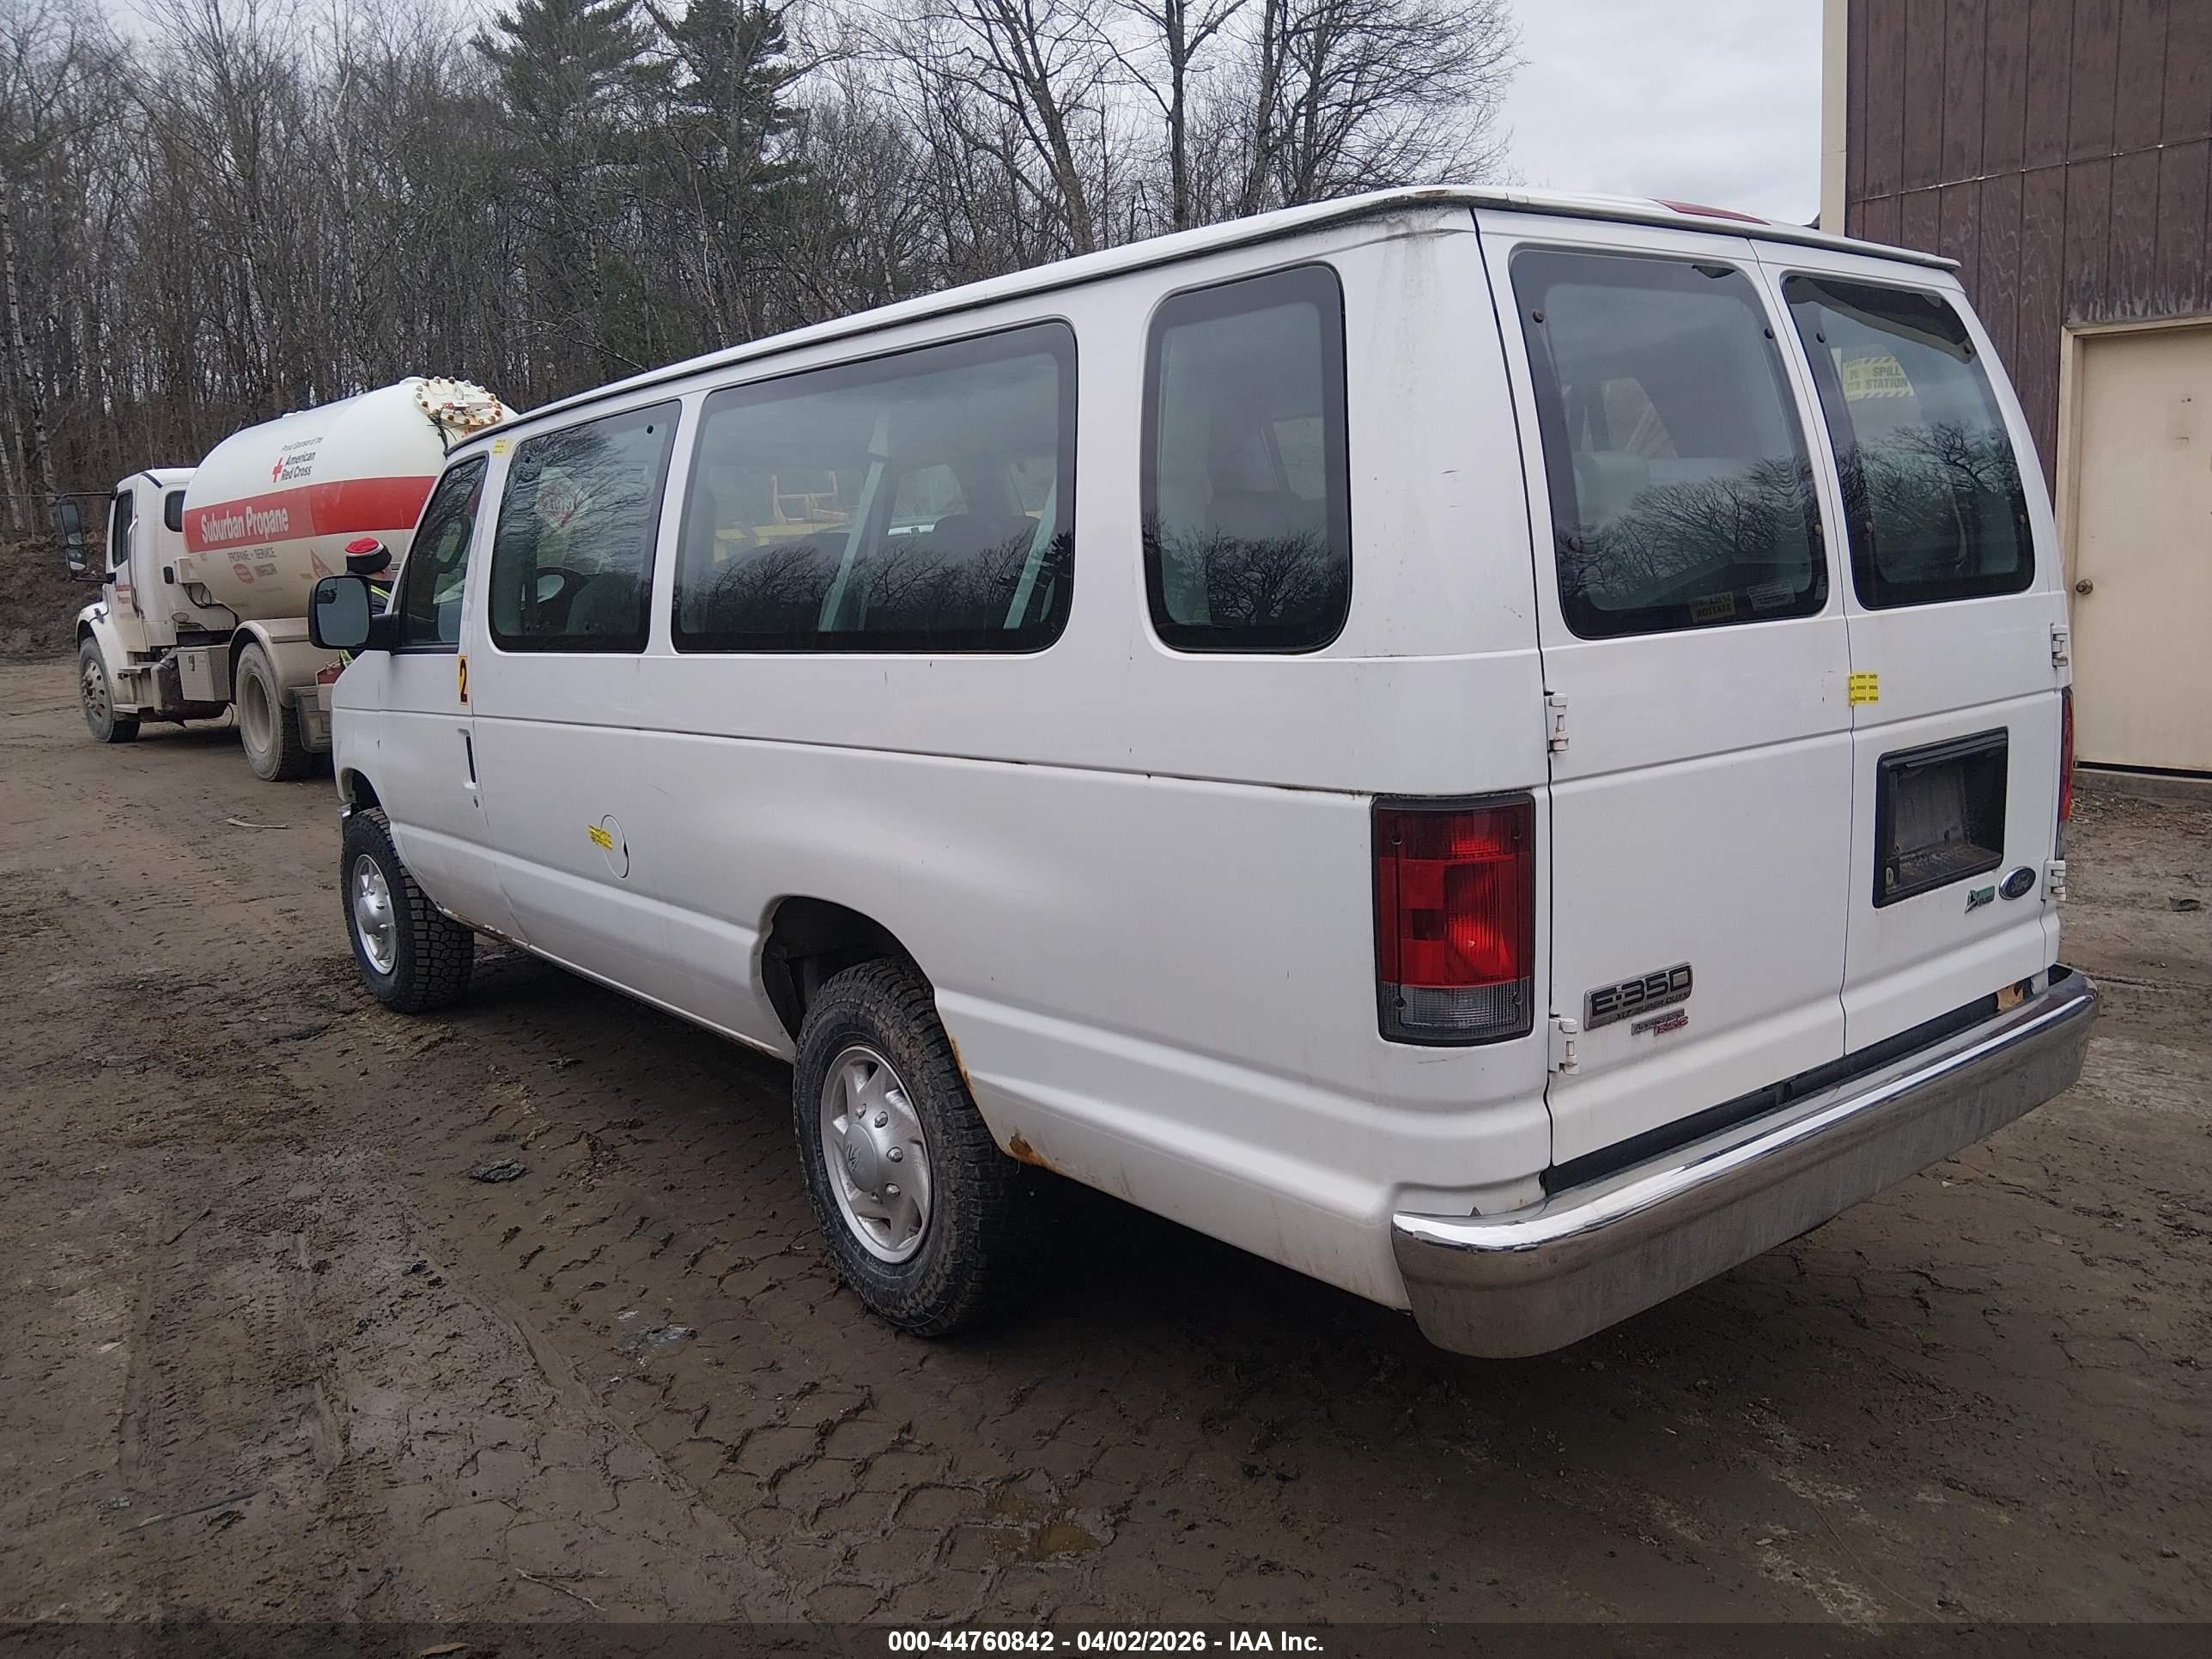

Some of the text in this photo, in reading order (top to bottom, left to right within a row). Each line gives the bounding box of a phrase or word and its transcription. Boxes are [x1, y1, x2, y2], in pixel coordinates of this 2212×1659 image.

[1873, 364, 1901, 377] SPILL
[1864, 376, 1908, 390] STATION
[284, 452, 316, 466] American
[281, 465, 312, 481] Red Cross
[201, 506, 289, 544] Suburban Propane
[459, 658, 468, 702] 2
[1591, 965, 1692, 1017] E-350
[1666, 990, 1691, 1005] DUTY
